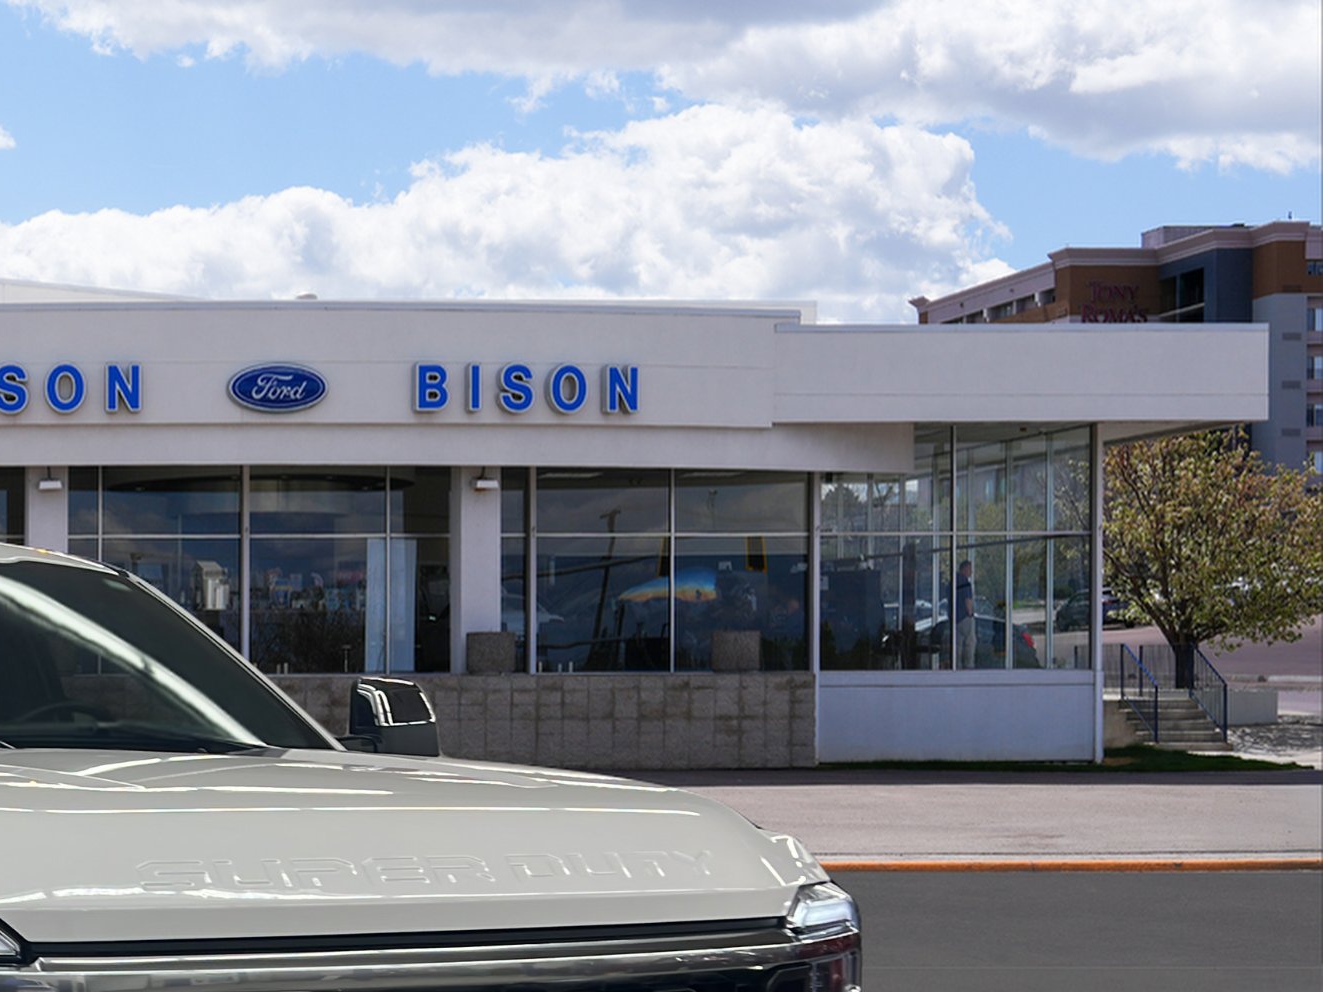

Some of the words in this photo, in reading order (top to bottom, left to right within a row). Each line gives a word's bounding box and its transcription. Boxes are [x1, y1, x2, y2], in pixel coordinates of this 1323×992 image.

[1085, 282, 1139, 302] TONY
[251, 373, 308, 400] Ford
[415, 363, 640, 414] BISON
[135, 853, 496, 891] SUPER
[504, 849, 712, 880] DUTY
